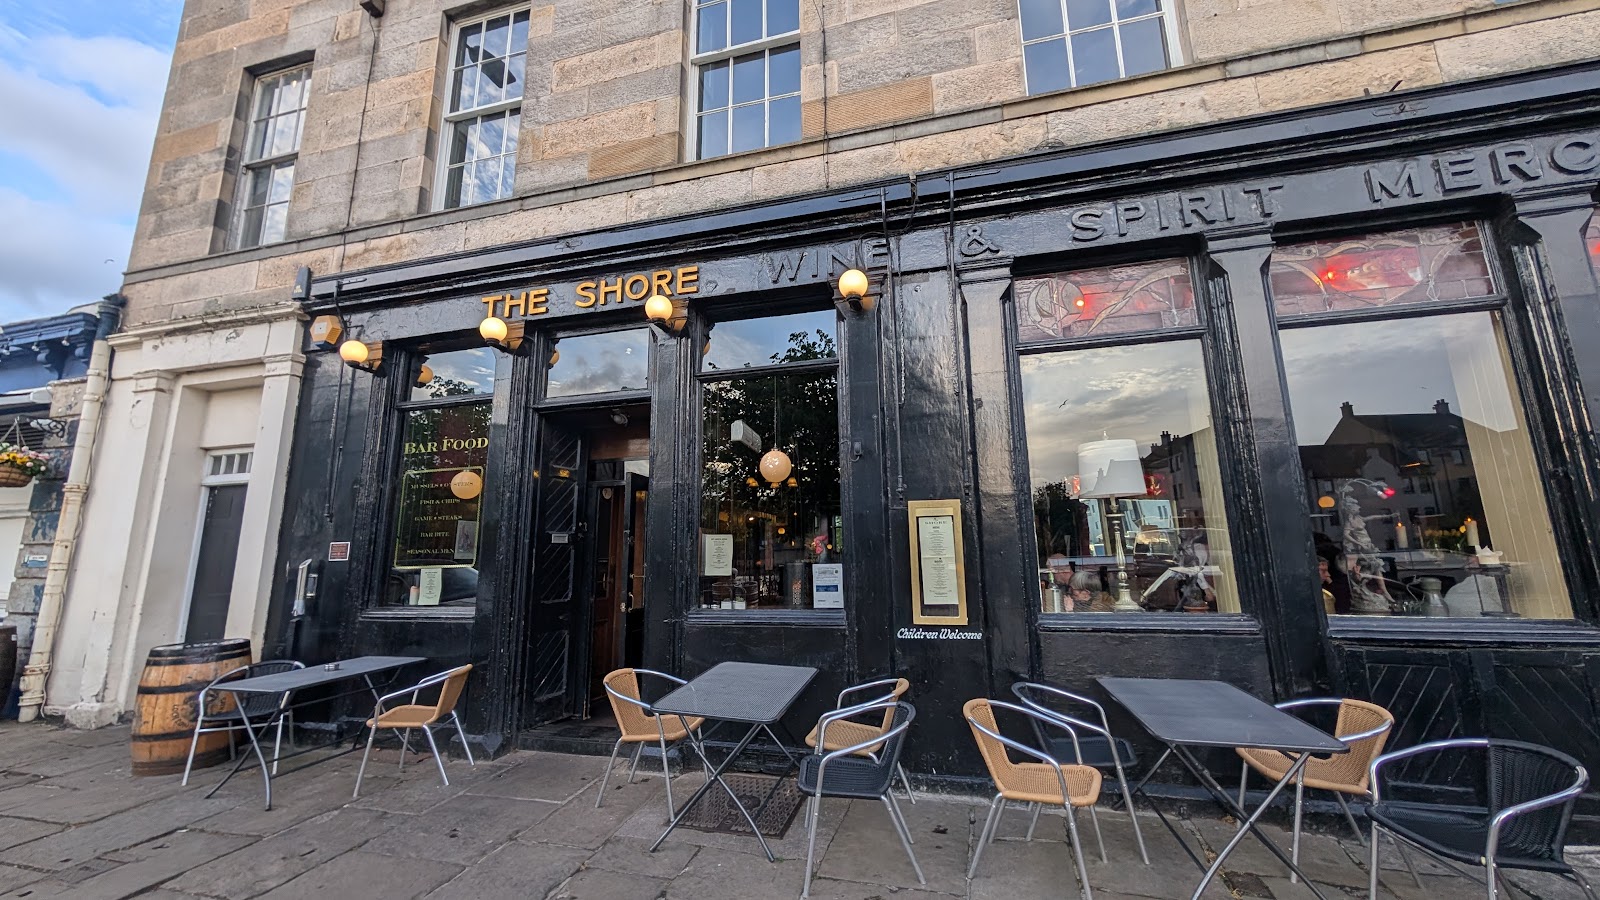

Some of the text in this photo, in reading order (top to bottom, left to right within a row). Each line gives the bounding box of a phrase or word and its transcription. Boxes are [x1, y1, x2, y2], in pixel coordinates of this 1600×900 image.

[766, 137, 1600, 283] WINE & SPIRIT MERC
[482, 266, 698, 318] THE SHORE
[404, 437, 489, 454] BAR FOOD
[897, 627, 982, 639] Children Welcome
